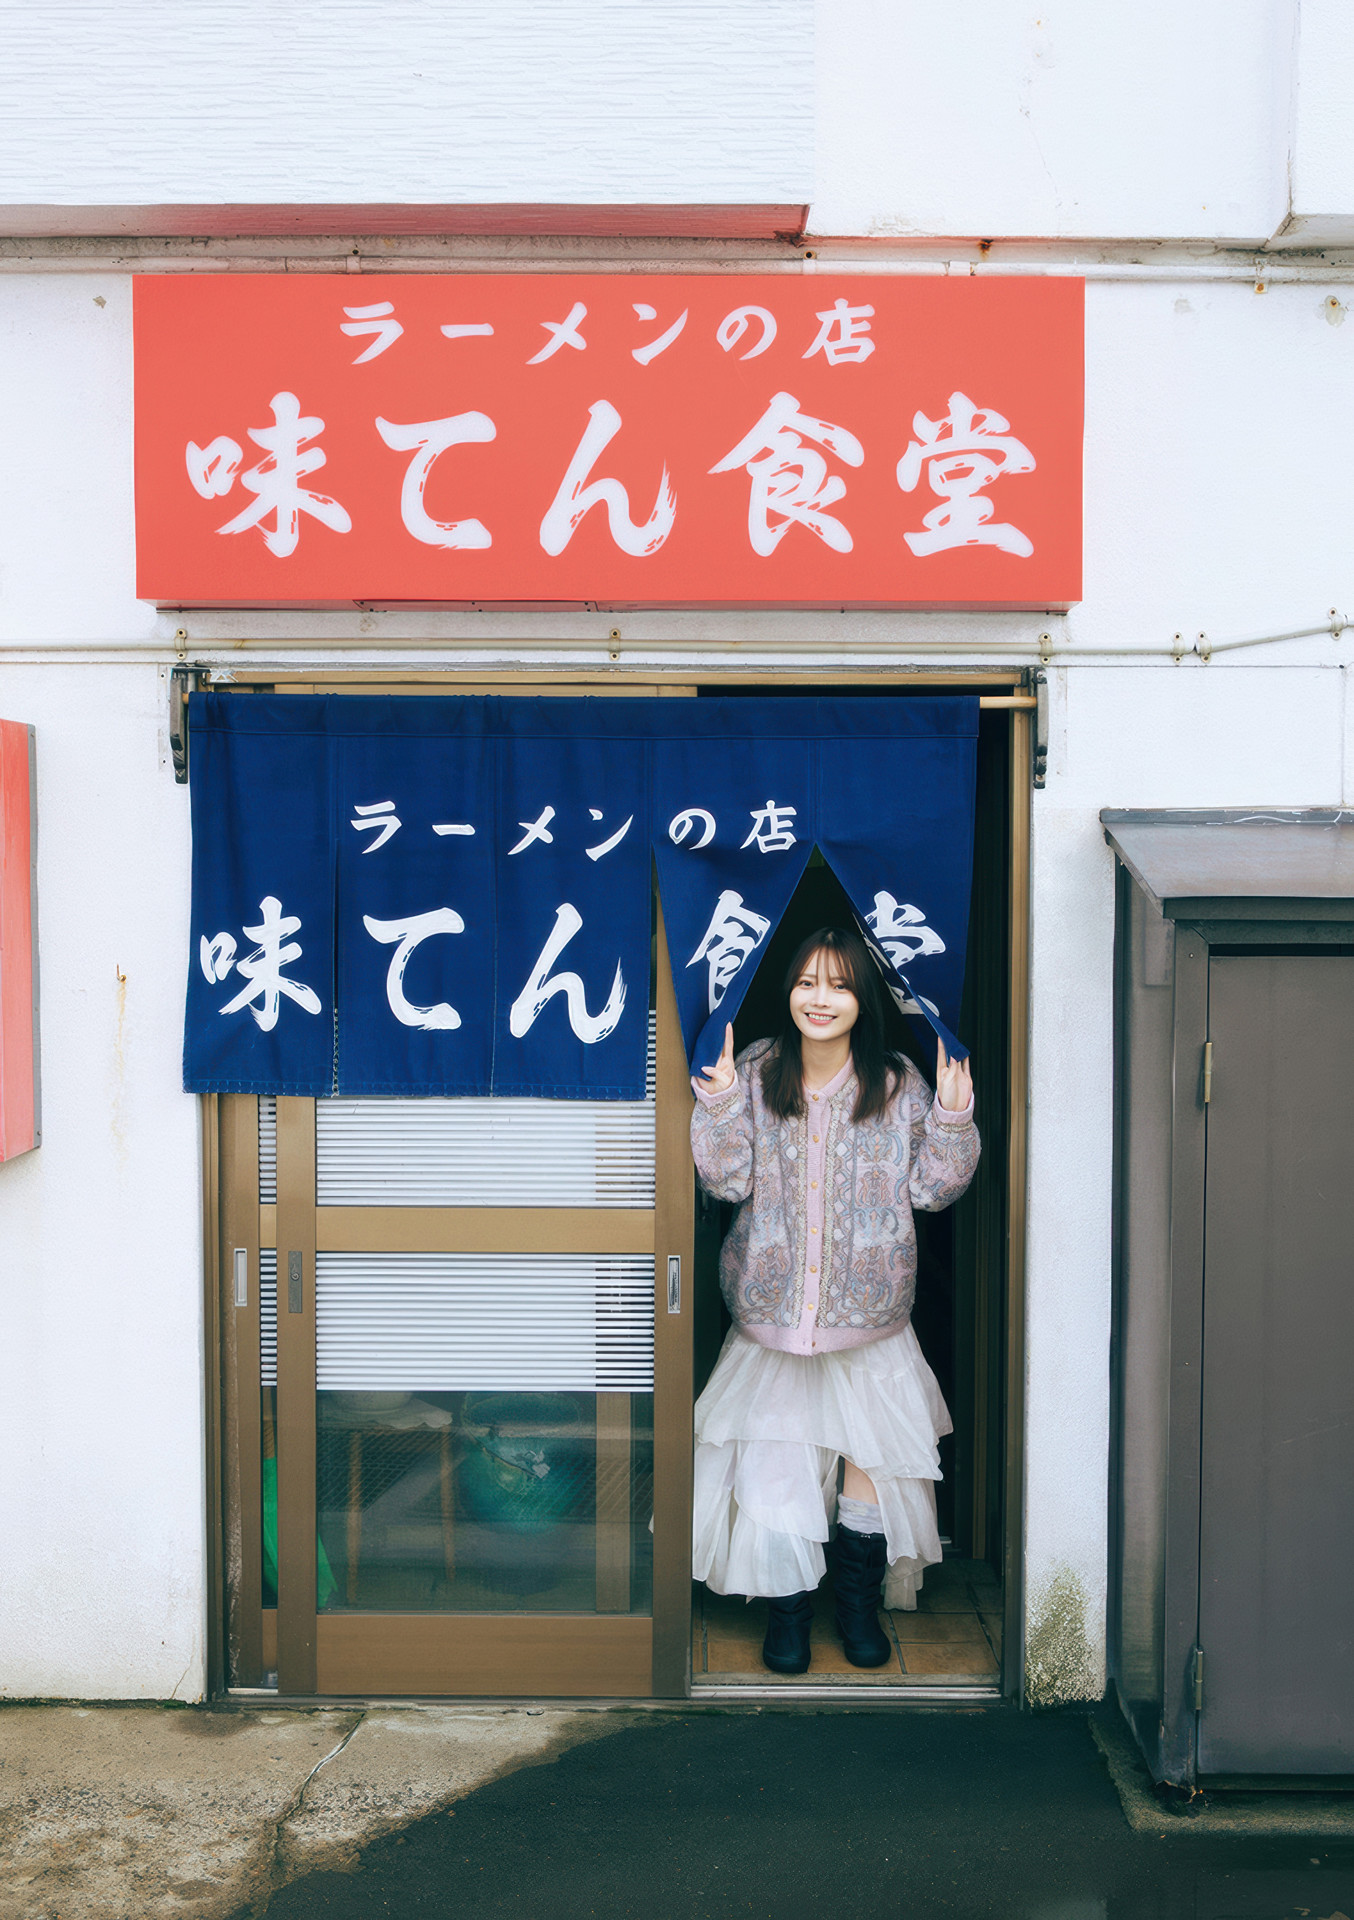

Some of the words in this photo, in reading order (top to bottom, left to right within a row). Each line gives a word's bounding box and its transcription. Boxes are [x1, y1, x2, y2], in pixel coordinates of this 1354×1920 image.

[339, 298, 876, 366] ラーメンの店
[185, 391, 1037, 558] 味てん食堂
[350, 799, 798, 862] ラーメンの店
